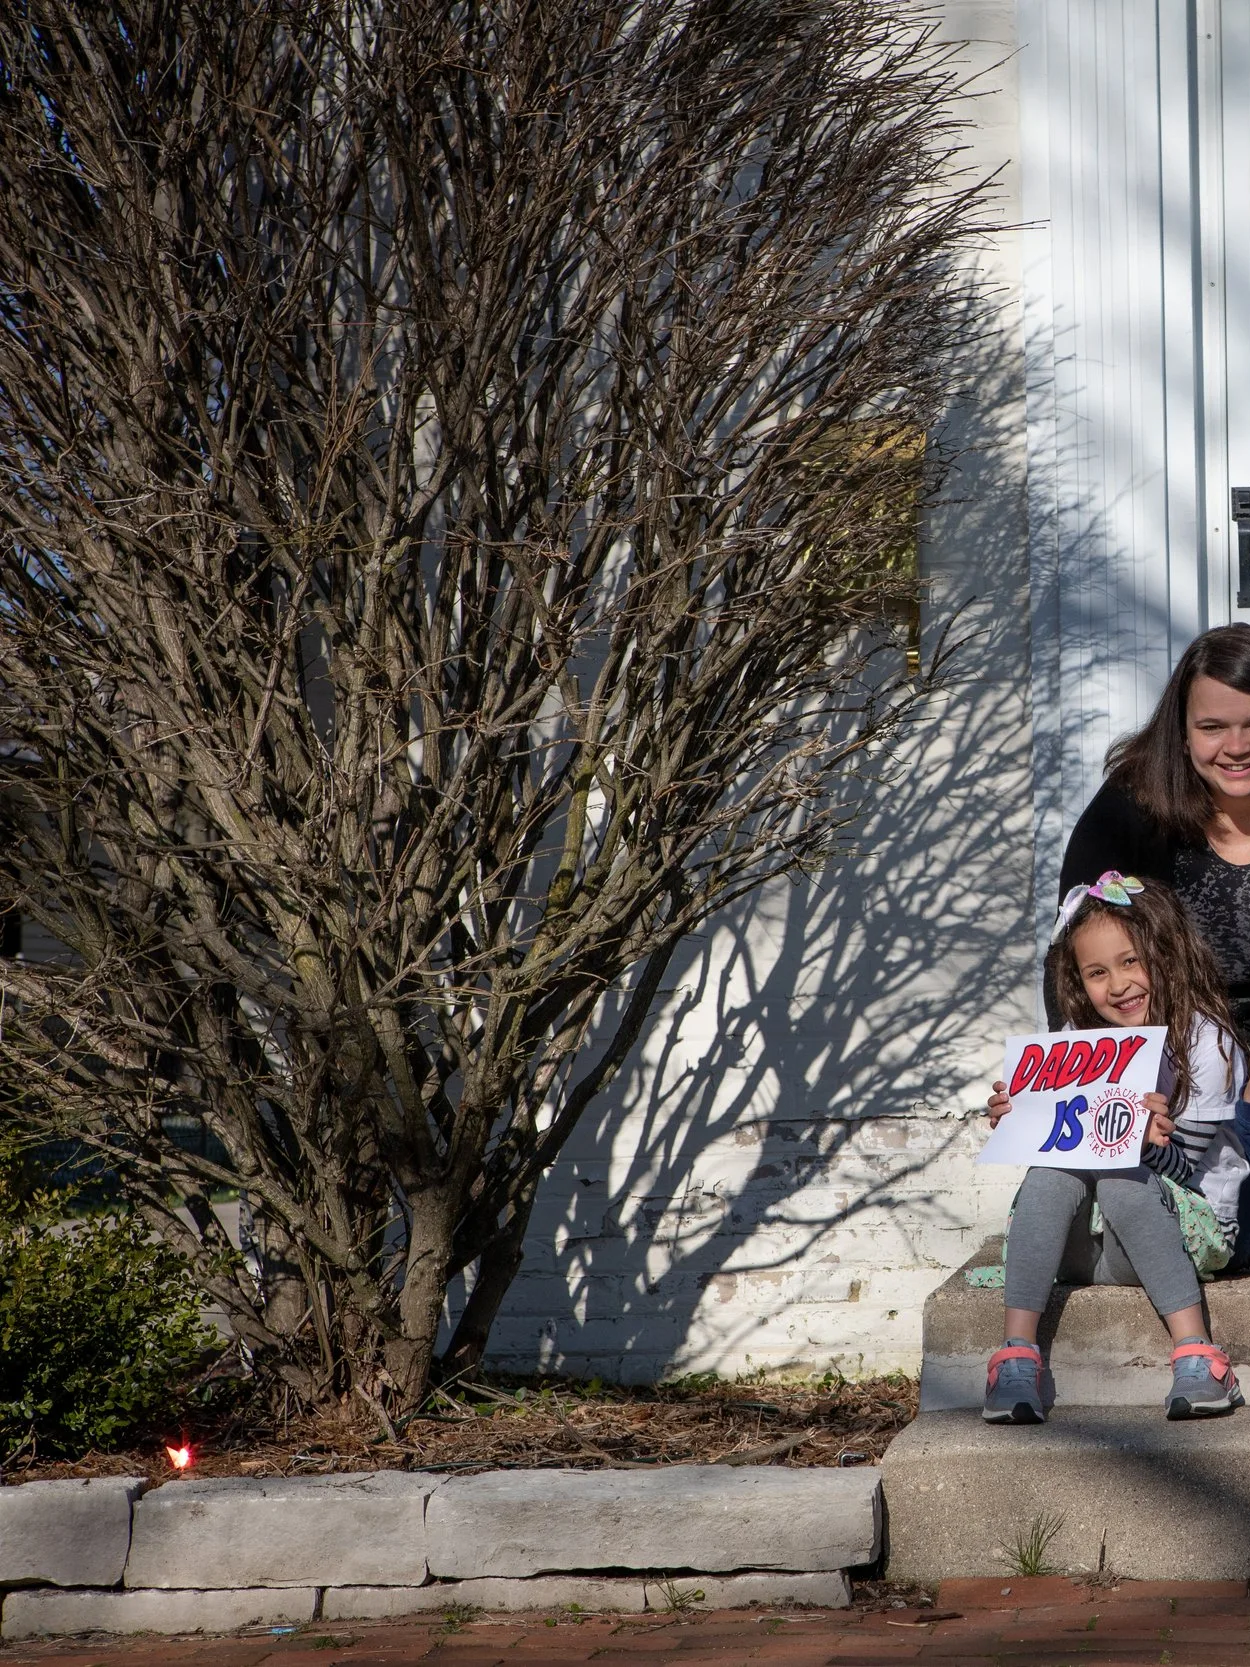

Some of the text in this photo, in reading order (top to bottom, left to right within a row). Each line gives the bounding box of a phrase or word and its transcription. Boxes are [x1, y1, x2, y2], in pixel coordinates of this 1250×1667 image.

[1009, 1035, 1147, 1097] DADDY
[1038, 1094, 1089, 1152] IS
[1086, 1131, 1106, 1158] FIRE
[1097, 1102, 1132, 1142] MFD
